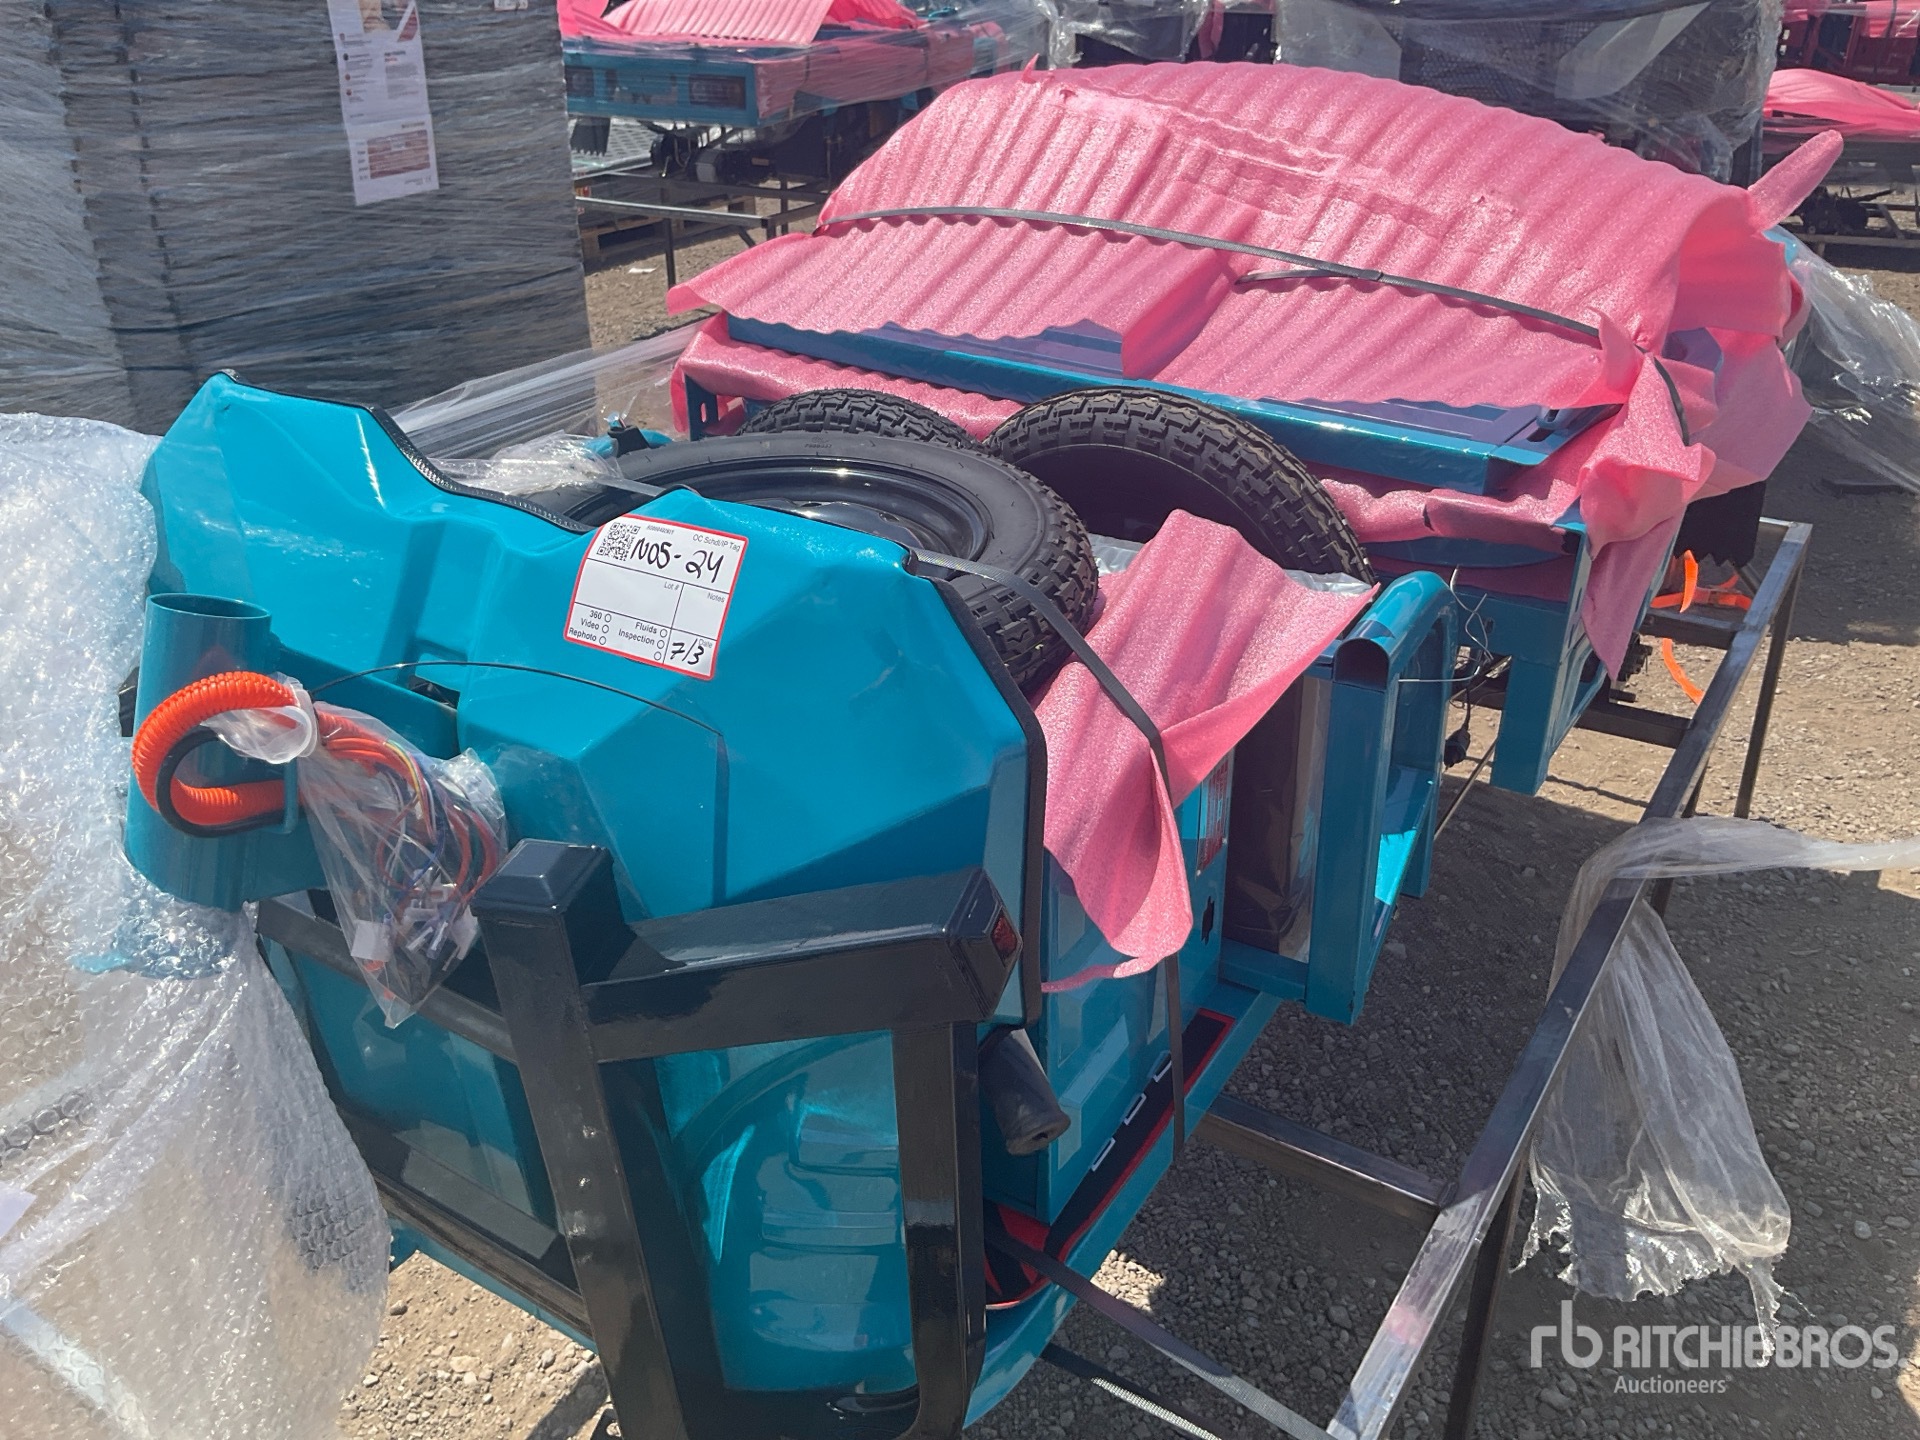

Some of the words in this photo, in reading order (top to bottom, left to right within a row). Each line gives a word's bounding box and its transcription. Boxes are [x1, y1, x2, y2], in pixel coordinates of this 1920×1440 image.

[730, 541, 741, 552] Tag
[664, 581, 674, 590] Lot
[707, 592, 725, 603] Notes
[589, 610, 602, 620] 360
[581, 618, 599, 630] Video
[635, 622, 657, 634] Fluids
[568, 627, 597, 642] Rephoto
[618, 628, 655, 645] Inspection
[670, 638, 704, 665] 7/3
